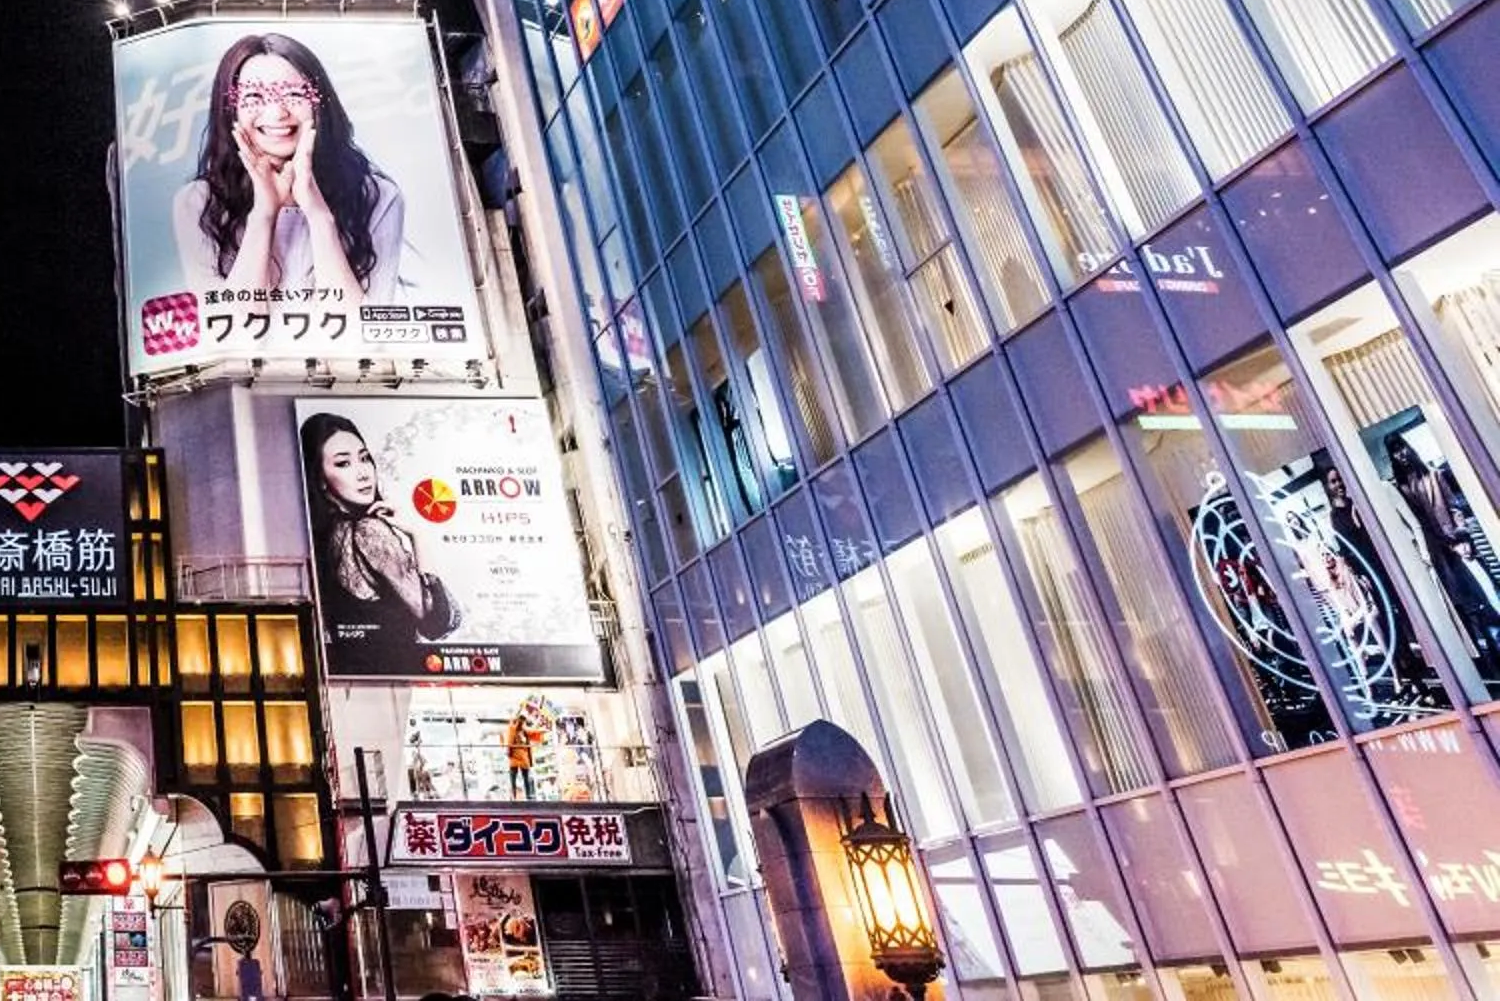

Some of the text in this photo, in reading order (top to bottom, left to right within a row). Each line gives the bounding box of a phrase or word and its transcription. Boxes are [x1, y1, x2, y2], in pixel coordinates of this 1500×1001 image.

[204, 288, 344, 305] 運命の出会いアプリ
[206, 312, 348, 342] ワクワク
[460, 476, 542, 499] ARROW
[444, 816, 562, 855] ダイコク
[565, 816, 623, 847] 免税
